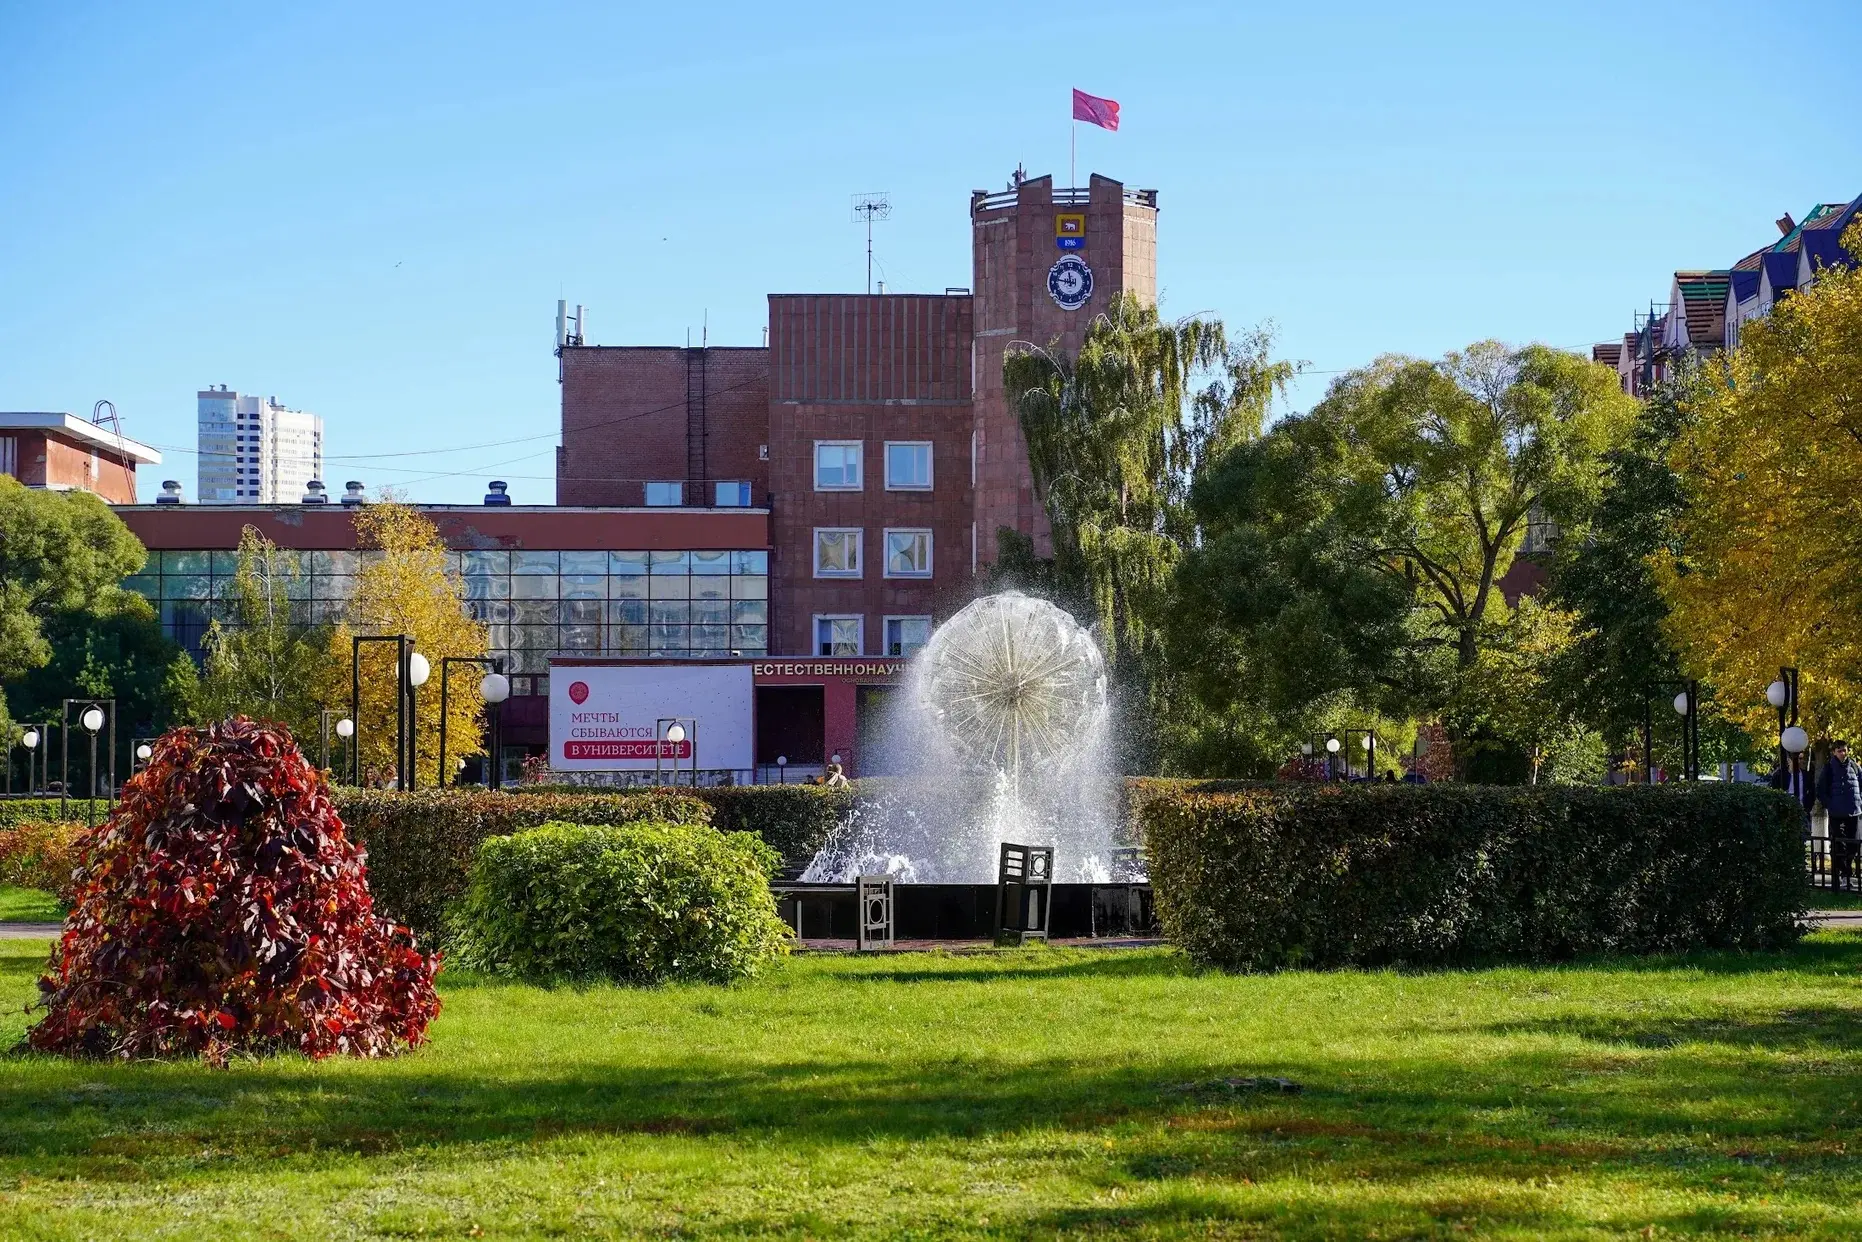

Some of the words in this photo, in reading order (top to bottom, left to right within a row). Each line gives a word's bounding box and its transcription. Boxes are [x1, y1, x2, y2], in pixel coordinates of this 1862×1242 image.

[571, 712, 620, 723] МЕЧТЫ
[571, 727, 653, 738] СБЫВАЮТСЯ
[571, 745, 580, 756] В
